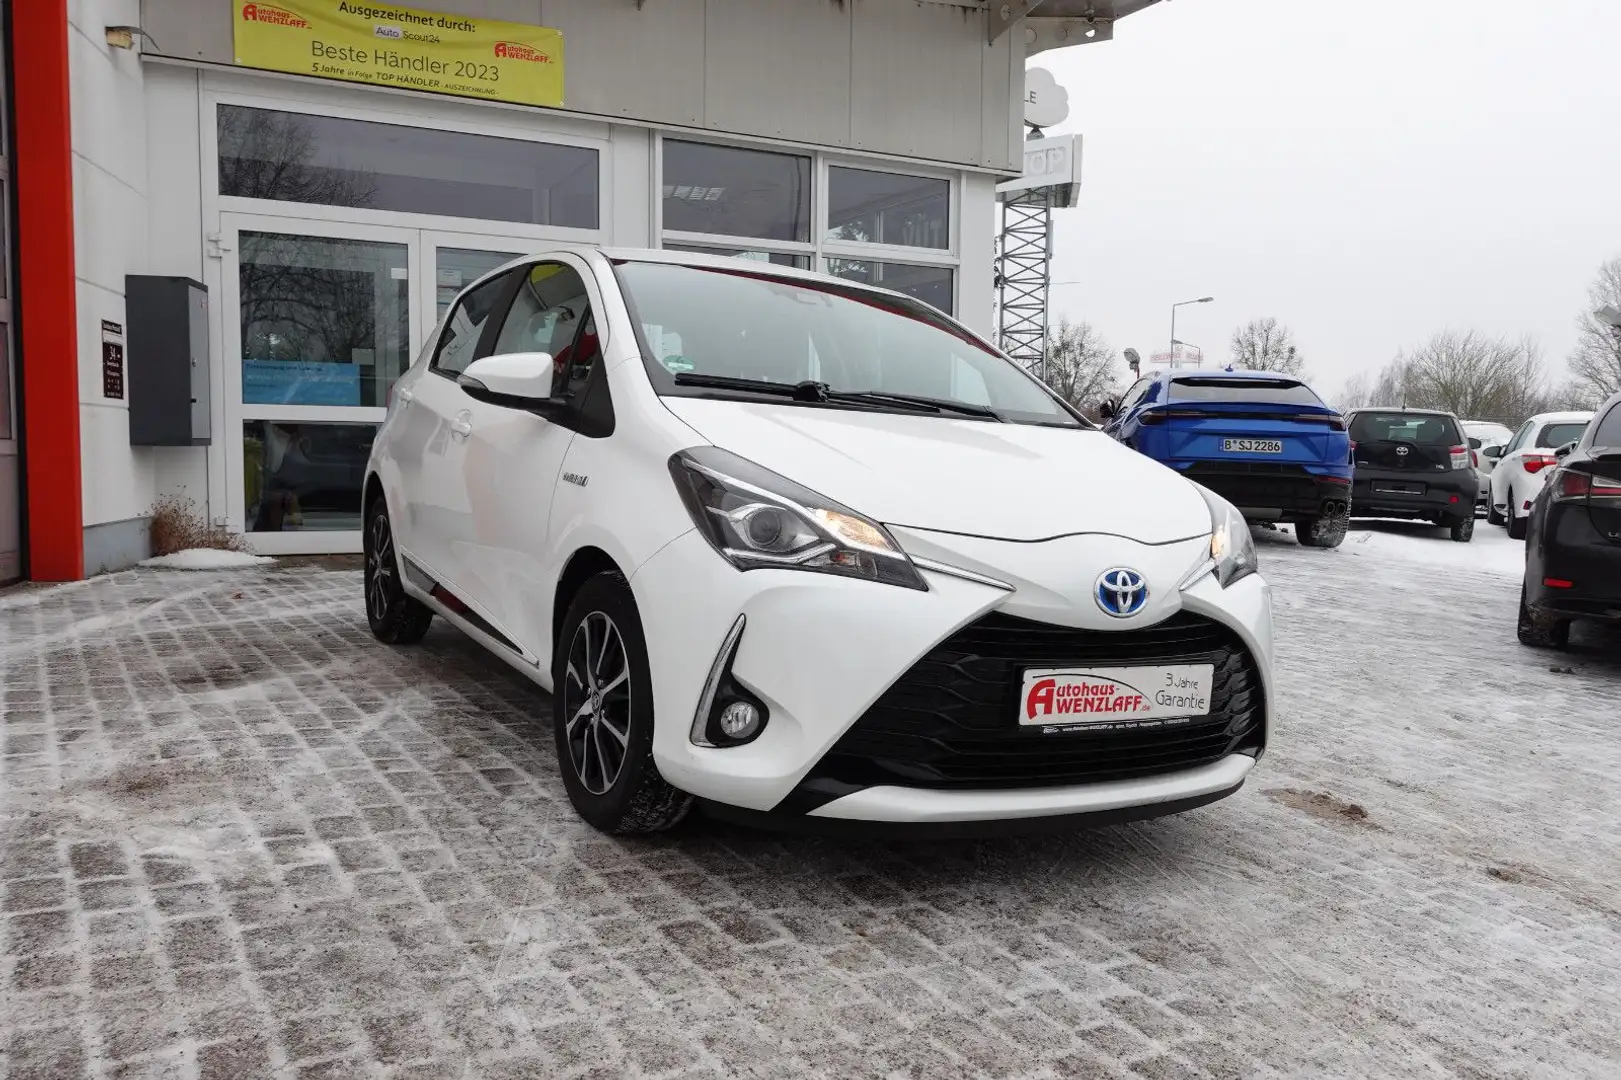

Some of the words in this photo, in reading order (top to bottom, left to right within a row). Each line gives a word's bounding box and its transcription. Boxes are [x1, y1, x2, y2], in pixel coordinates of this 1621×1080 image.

[339, 1, 434, 26] Ausgezeichnet
[437, 16, 476, 33] durch:
[376, 27, 400, 38] Auto
[403, 31, 440, 44] Scout24
[312, 40, 368, 64] Beste
[374, 50, 450, 75] Händler
[455, 61, 499, 82] 2023
[312, 62, 319, 72] 5
[320, 65, 345, 74] Jahre
[376, 72, 395, 81] TOP
[1224, 440, 1232, 449] B
[1254, 441, 1280, 452] 2286
[1165, 672, 1174, 687] 3
[1174, 677, 1199, 690] Jahre
[1155, 689, 1205, 709] Garantie
